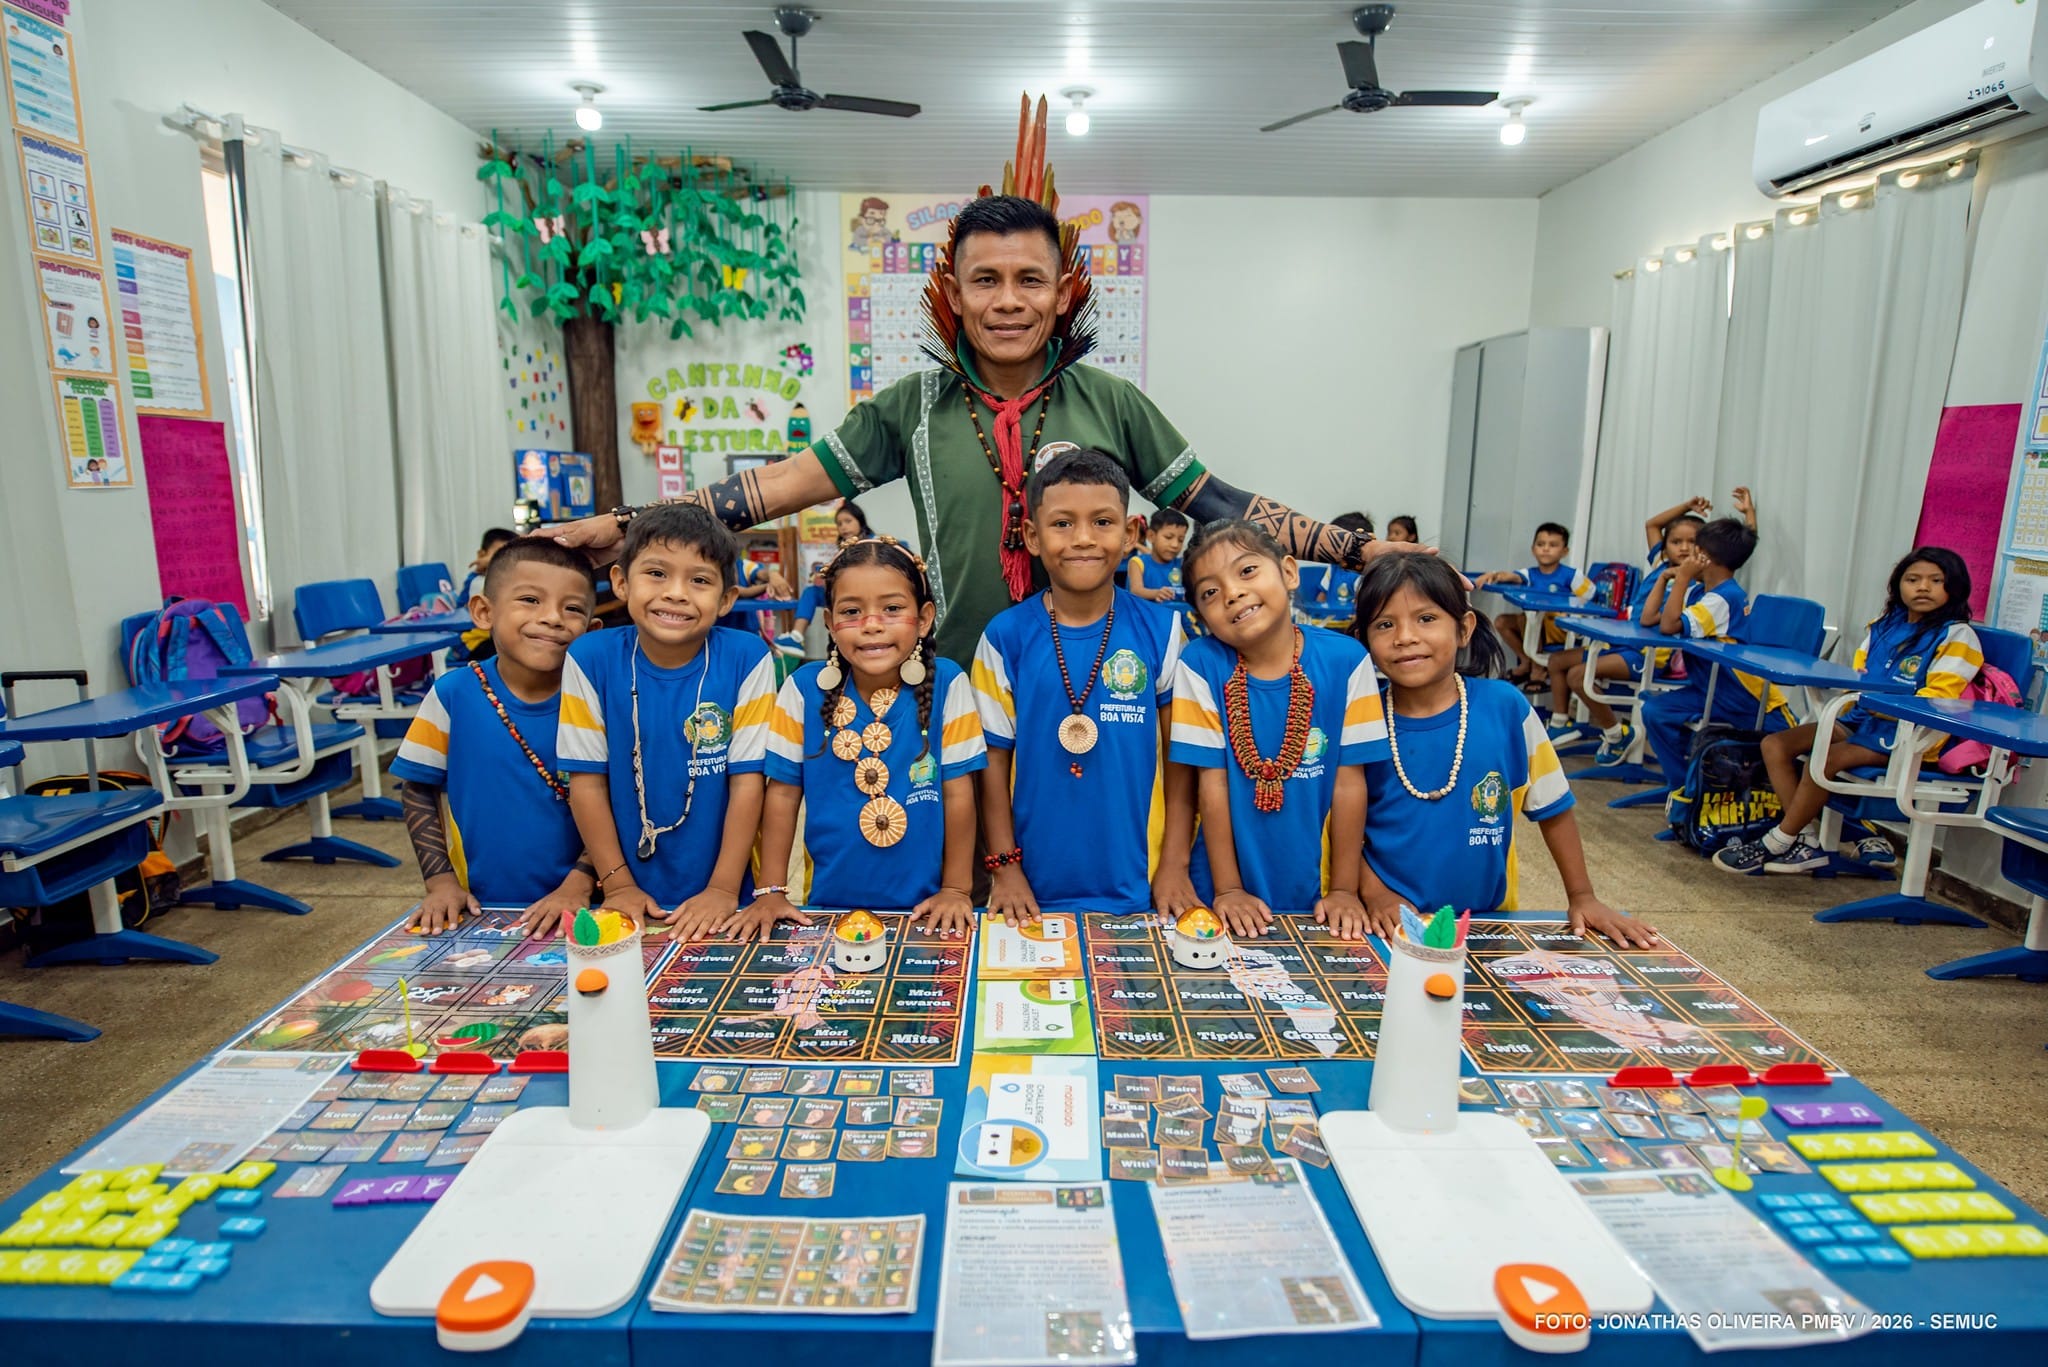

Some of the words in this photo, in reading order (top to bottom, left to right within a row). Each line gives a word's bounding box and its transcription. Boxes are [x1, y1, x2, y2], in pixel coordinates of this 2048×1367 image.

[646, 363, 801, 401] CANTINHO
[702, 396, 740, 419] DA
[668, 429, 784, 452] LEITURA
[1100, 712, 1119, 722] BOA
[1121, 712, 1144, 723] VISTA
[688, 766, 710, 777] BOA
[712, 762, 727, 774] VIS
[1469, 835, 1488, 846] BOA
[905, 958, 958, 966] Pana'to
[1323, 955, 1372, 963] Remo
[1111, 990, 1157, 999] Arco
[1179, 991, 1244, 999] Peneira
[1265, 992, 1318, 1002] Roça
[1341, 991, 1387, 1000] Flech
[1031, 1008, 1040, 1032] BOOKLET
[890, 1033, 940, 1044] Mita
[1114, 1031, 1166, 1042] Tipiti
[1283, 1029, 1348, 1041] Goma
[1024, 1083, 1035, 1115] BOOKLET
[1035, 1084, 1045, 1125] CHALLENGE
[897, 1130, 927, 1138] Boca
